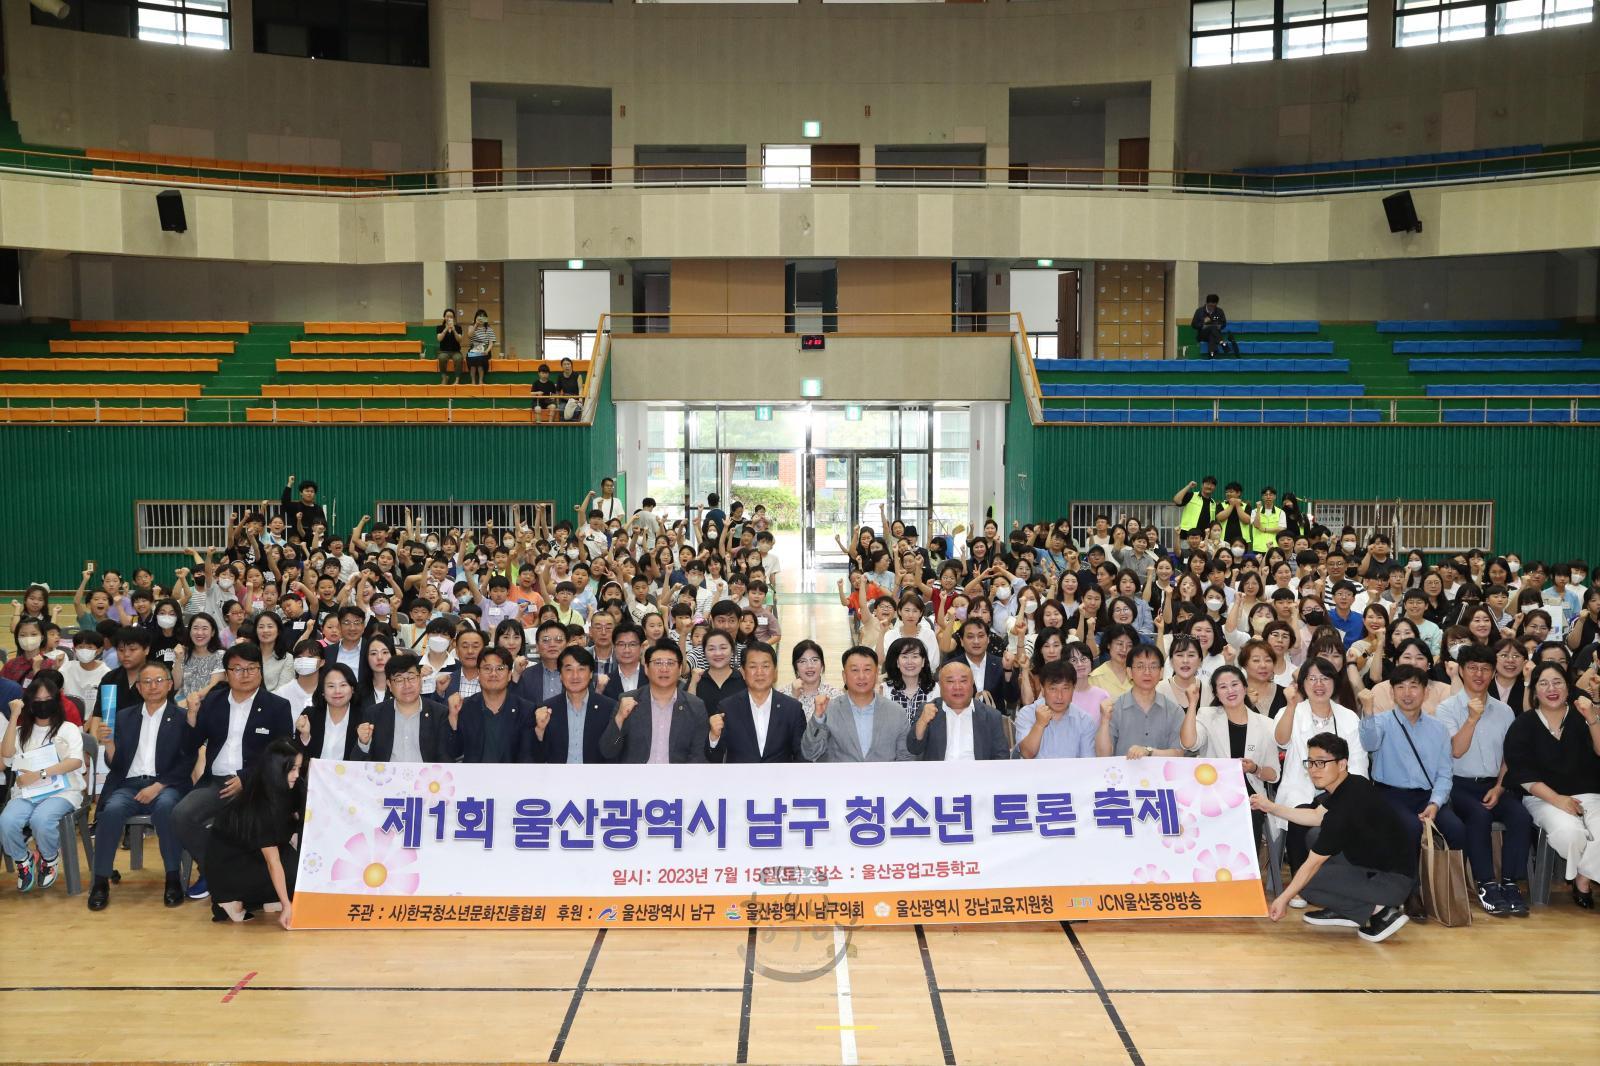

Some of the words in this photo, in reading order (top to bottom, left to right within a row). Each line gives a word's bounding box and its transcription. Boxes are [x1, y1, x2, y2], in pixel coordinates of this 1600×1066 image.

[381, 796, 495, 850] 제1회
[512, 797, 728, 851] 울산광역시
[745, 798, 831, 848] 남구
[845, 794, 975, 847] 청소년
[991, 793, 1077, 838] 토론
[1093, 787, 1182, 837] 축제
[658, 867, 709, 884] 2023년
[714, 866, 738, 884] 7월
[744, 865, 801, 884] 15일(토)
[814, 864, 844, 882] 장소
[861, 860, 981, 880] 울산공업고등학교
[746, 901, 809, 920] 울산광역시
[814, 900, 864, 919] 남구의회
[896, 898, 960, 918] 울산광역시
[964, 895, 1054, 916] 강남교육지원청
[1097, 891, 1202, 912] JCN울산중앙방송
[347, 904, 374, 922] 주관
[388, 904, 546, 922] 사)한국청소년문화진흥협회
[557, 904, 583, 921] 후원
[622, 903, 685, 921] 울산광역시
[690, 904, 716, 921] 남구
